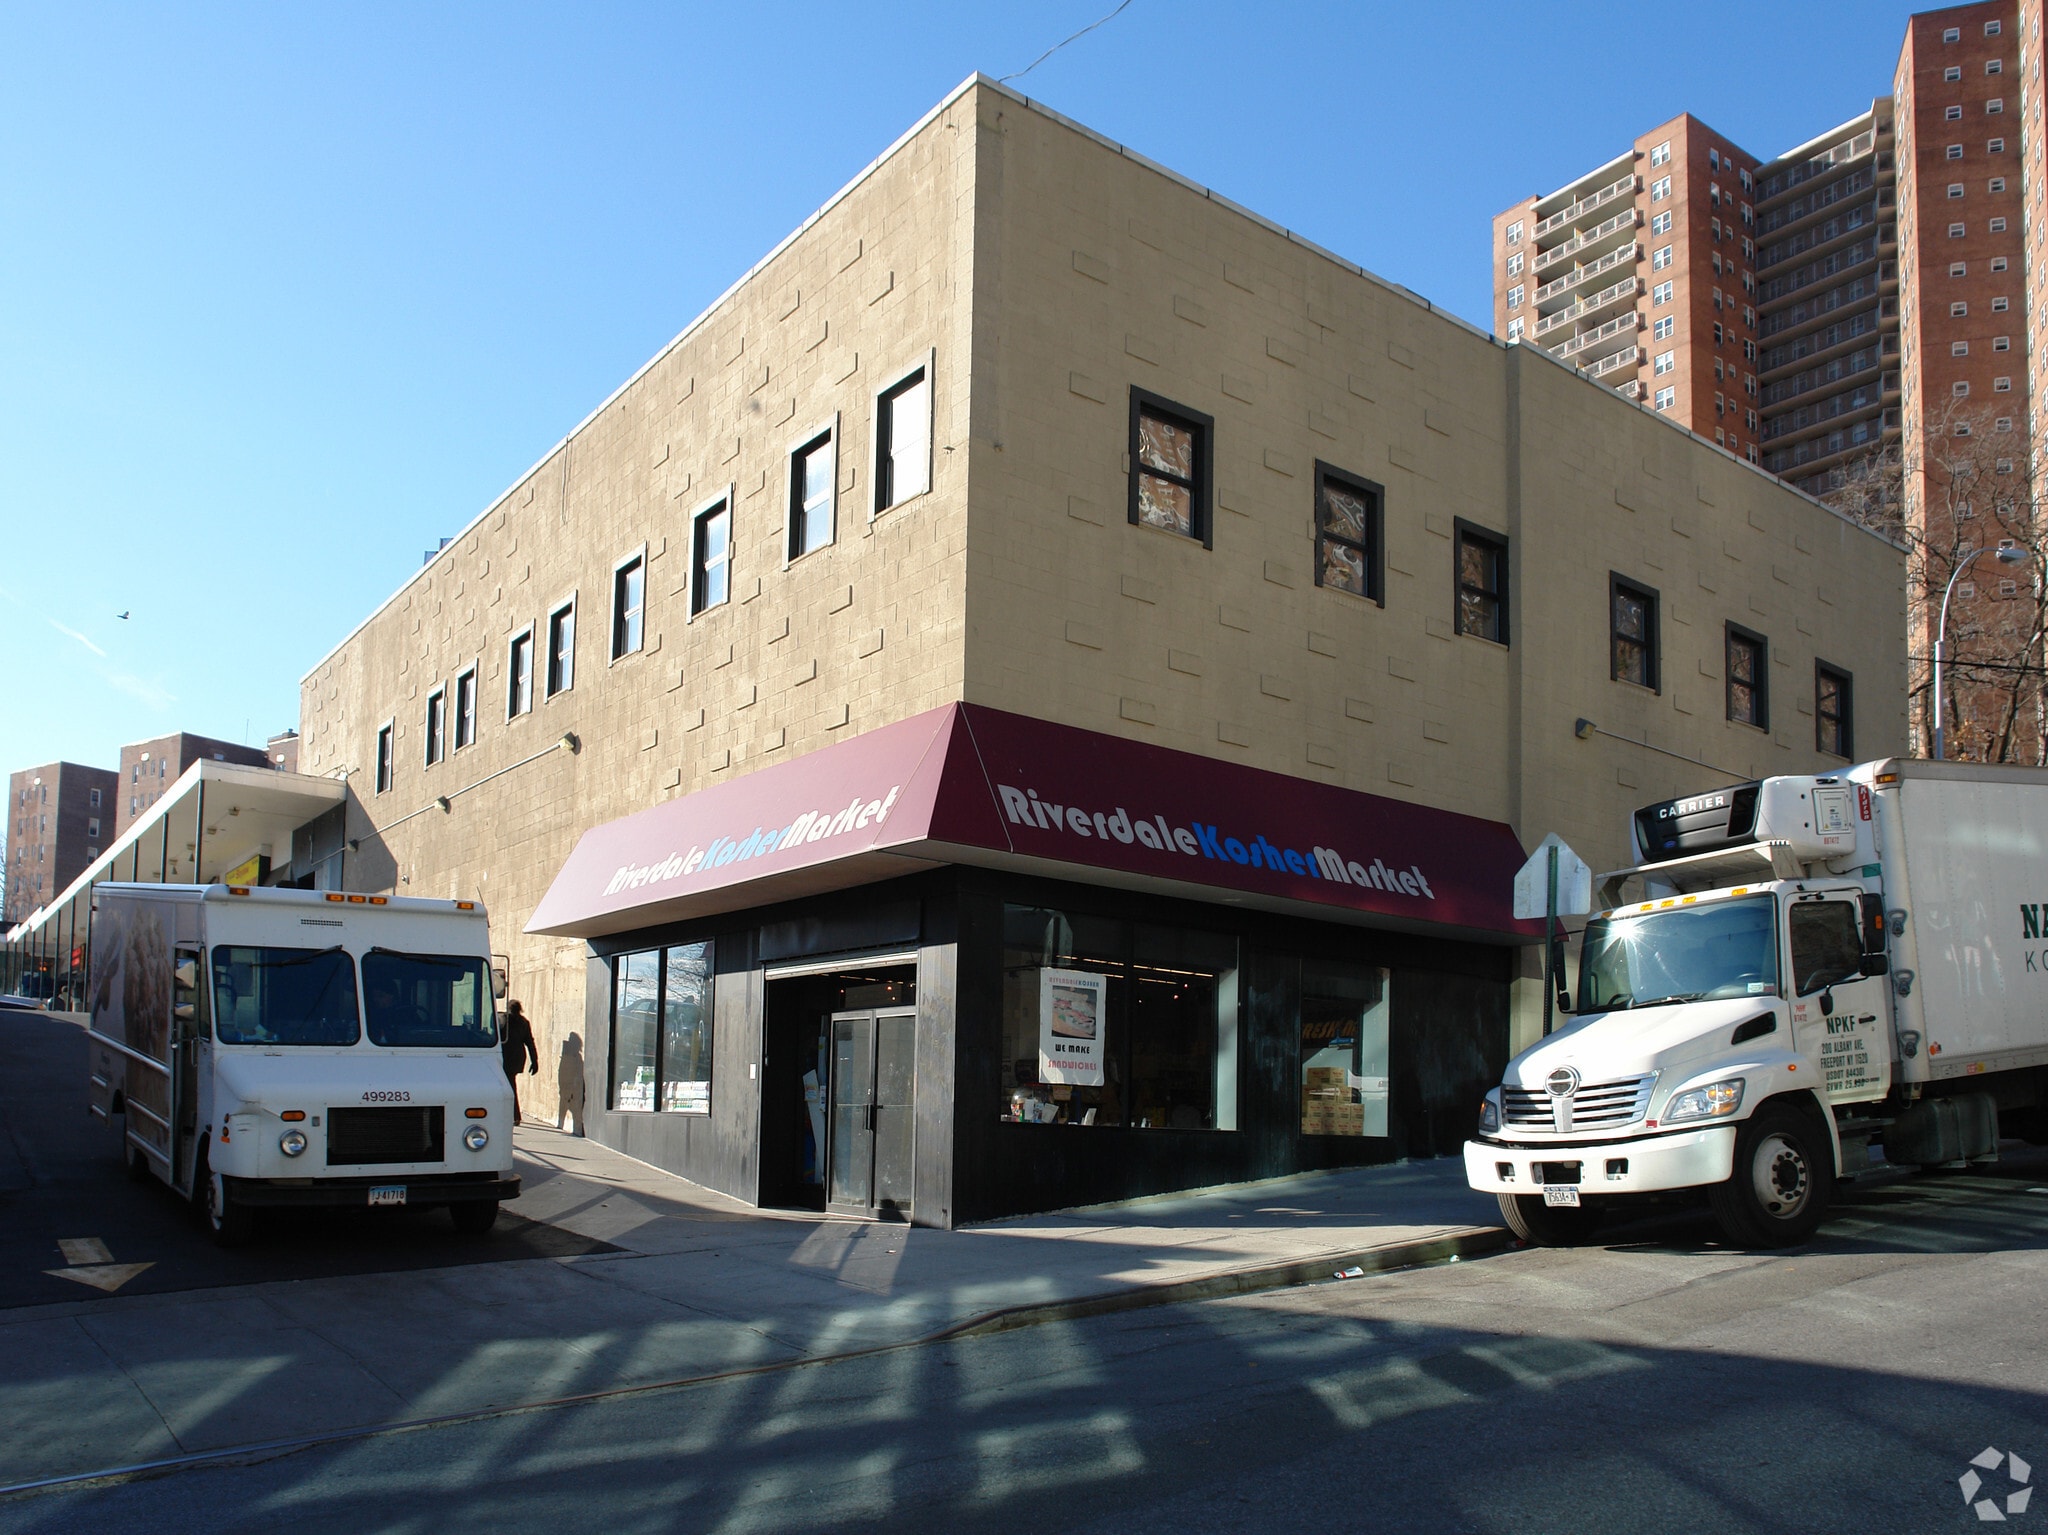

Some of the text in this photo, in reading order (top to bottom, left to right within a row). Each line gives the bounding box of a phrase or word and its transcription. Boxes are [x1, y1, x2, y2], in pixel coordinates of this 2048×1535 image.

[1659, 795, 1724, 819] CARRIER
[1860, 786, 1870, 820] Kidron
[1826, 1015, 1855, 1034] NPKF
[1055, 1043, 1090, 1055] WE MAKE
[1821, 1042, 1832, 1055] 200
[1834, 1040, 1853, 1053] ALBANY
[1048, 1059, 1097, 1071] SANDWICHES
[1820, 1052, 1868, 1068] FREEPORT NY 11520
[1826, 1070, 1844, 1081] USDOT
[1826, 1081, 1843, 1092] GVWR
[361, 1091, 410, 1102] 499283
